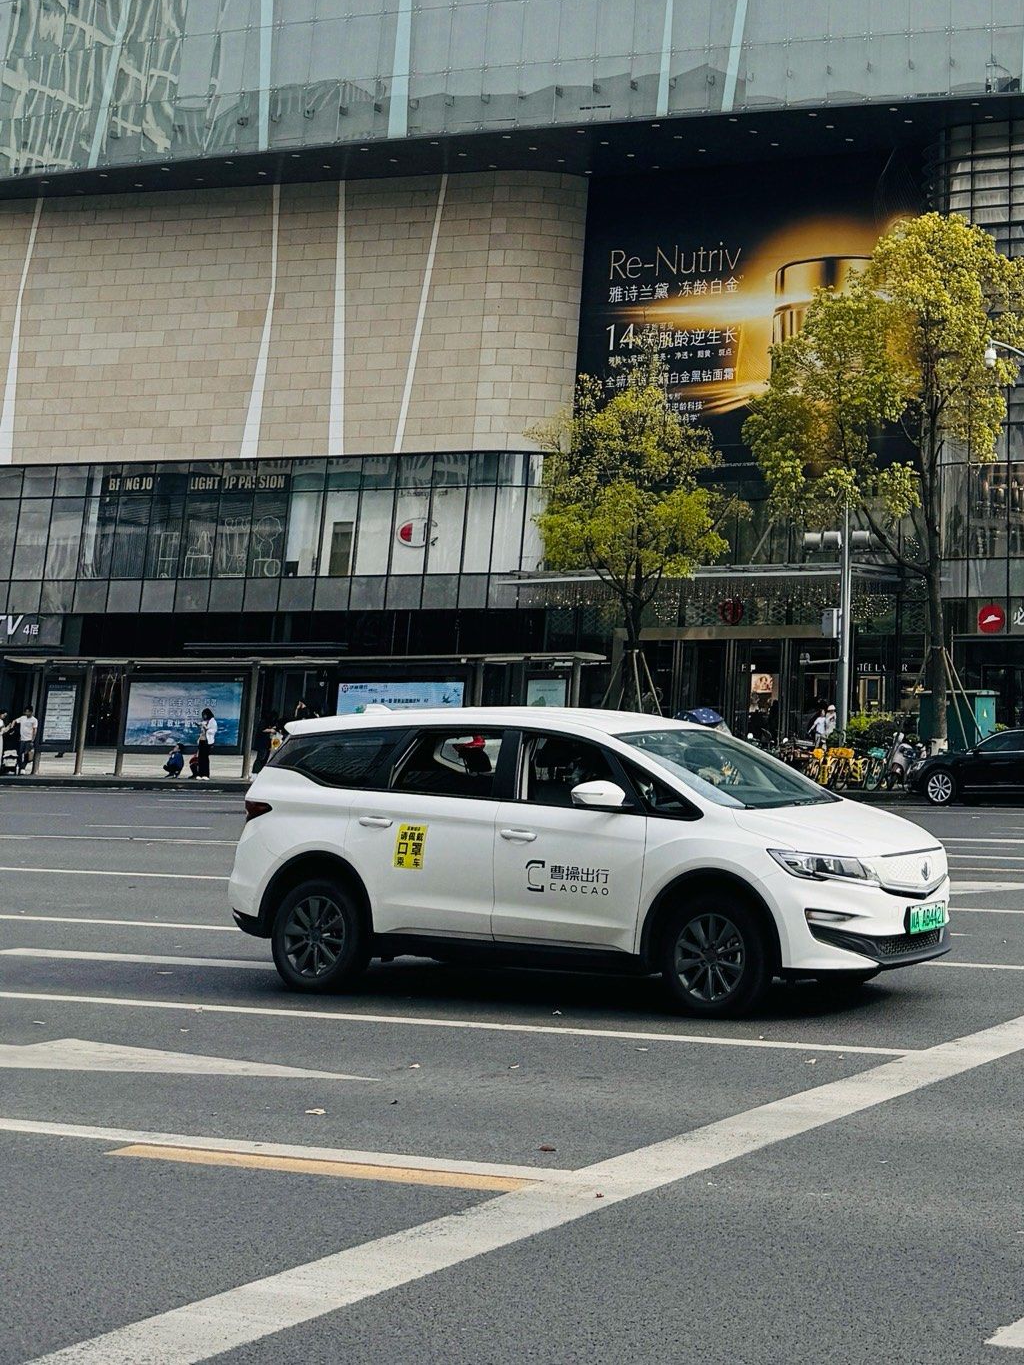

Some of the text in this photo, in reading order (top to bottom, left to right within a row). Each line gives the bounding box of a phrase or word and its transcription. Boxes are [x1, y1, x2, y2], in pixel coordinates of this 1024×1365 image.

[609, 241, 742, 280] Re-Nutriv
[608, 276, 740, 303] 雅诗兰黛 冻龄白金
[190, 476, 220, 490] LIGHT
[398, 842, 422, 856] 口罩
[397, 857, 420, 867] 乘车
[550, 865, 609, 883] 曹操出行
[549, 883, 609, 895] CAOCAO
